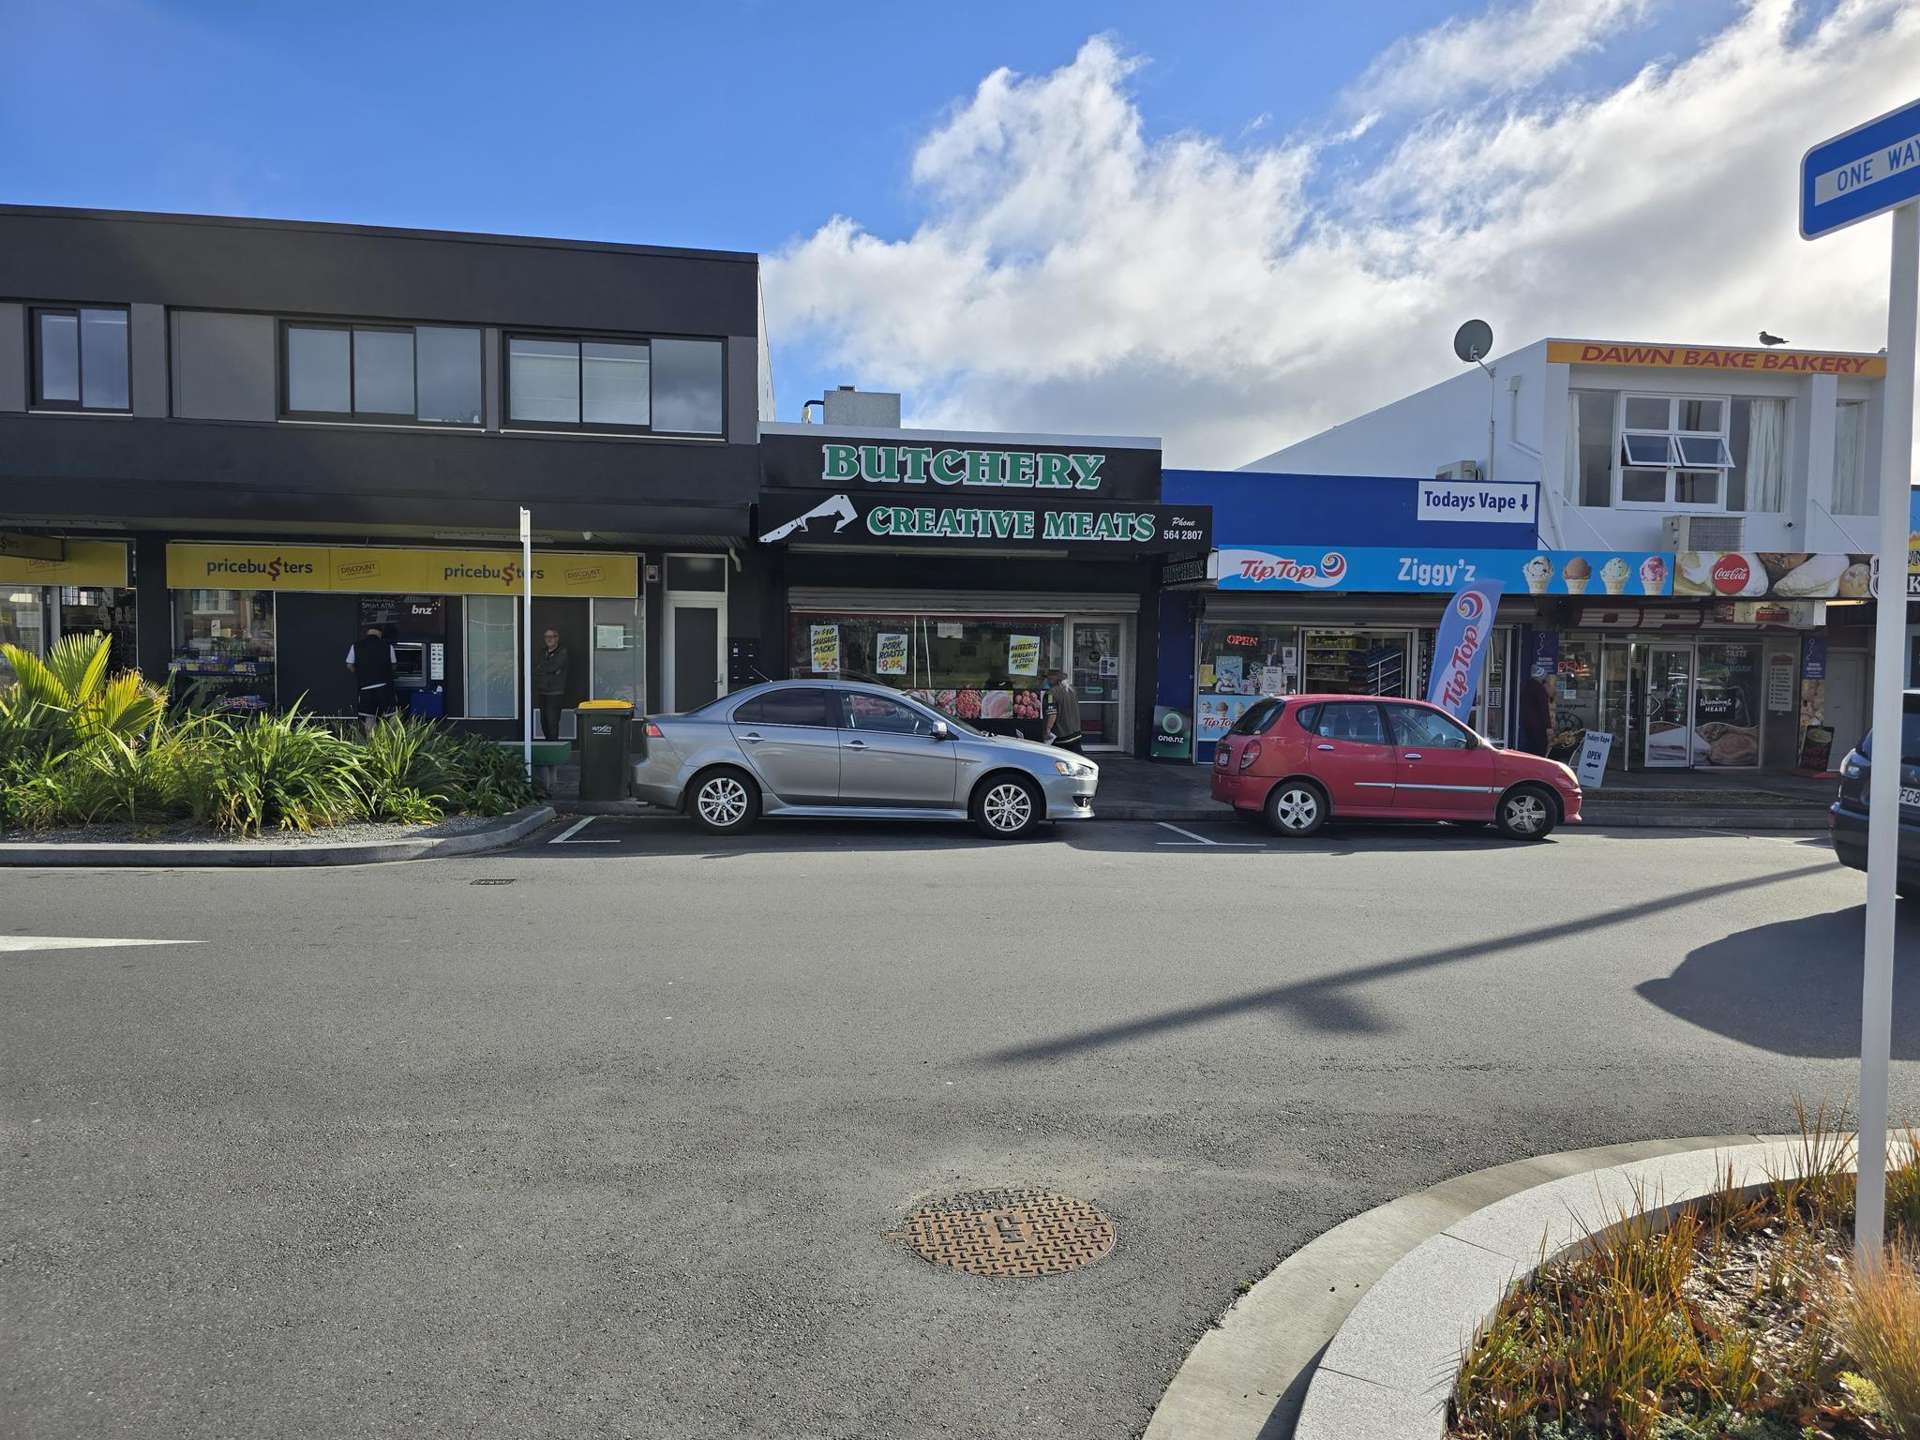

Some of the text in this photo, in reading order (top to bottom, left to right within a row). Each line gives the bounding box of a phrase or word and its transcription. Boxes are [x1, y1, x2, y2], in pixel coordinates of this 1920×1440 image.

[1837, 159, 1873, 191] ONE
[1580, 346, 1870, 373] DAWN BAKE BAKERY
[821, 444, 1106, 490] BUTCHERY
[1424, 490, 1516, 513] Todays Vape
[867, 506, 1156, 543] CREATIVE MEATS
[1172, 516, 1197, 527] Phone
[1163, 529, 1203, 540] 564 2807
[1240, 559, 1317, 582] Tip Top
[1398, 557, 1477, 586] Ziggy'z
[411, 604, 433, 615] bnz
[1226, 634, 1259, 646] OPEN
[1442, 625, 1478, 708] Tip Top
[1158, 734, 1184, 744] one.nz
[1586, 750, 1602, 760] OPEN
